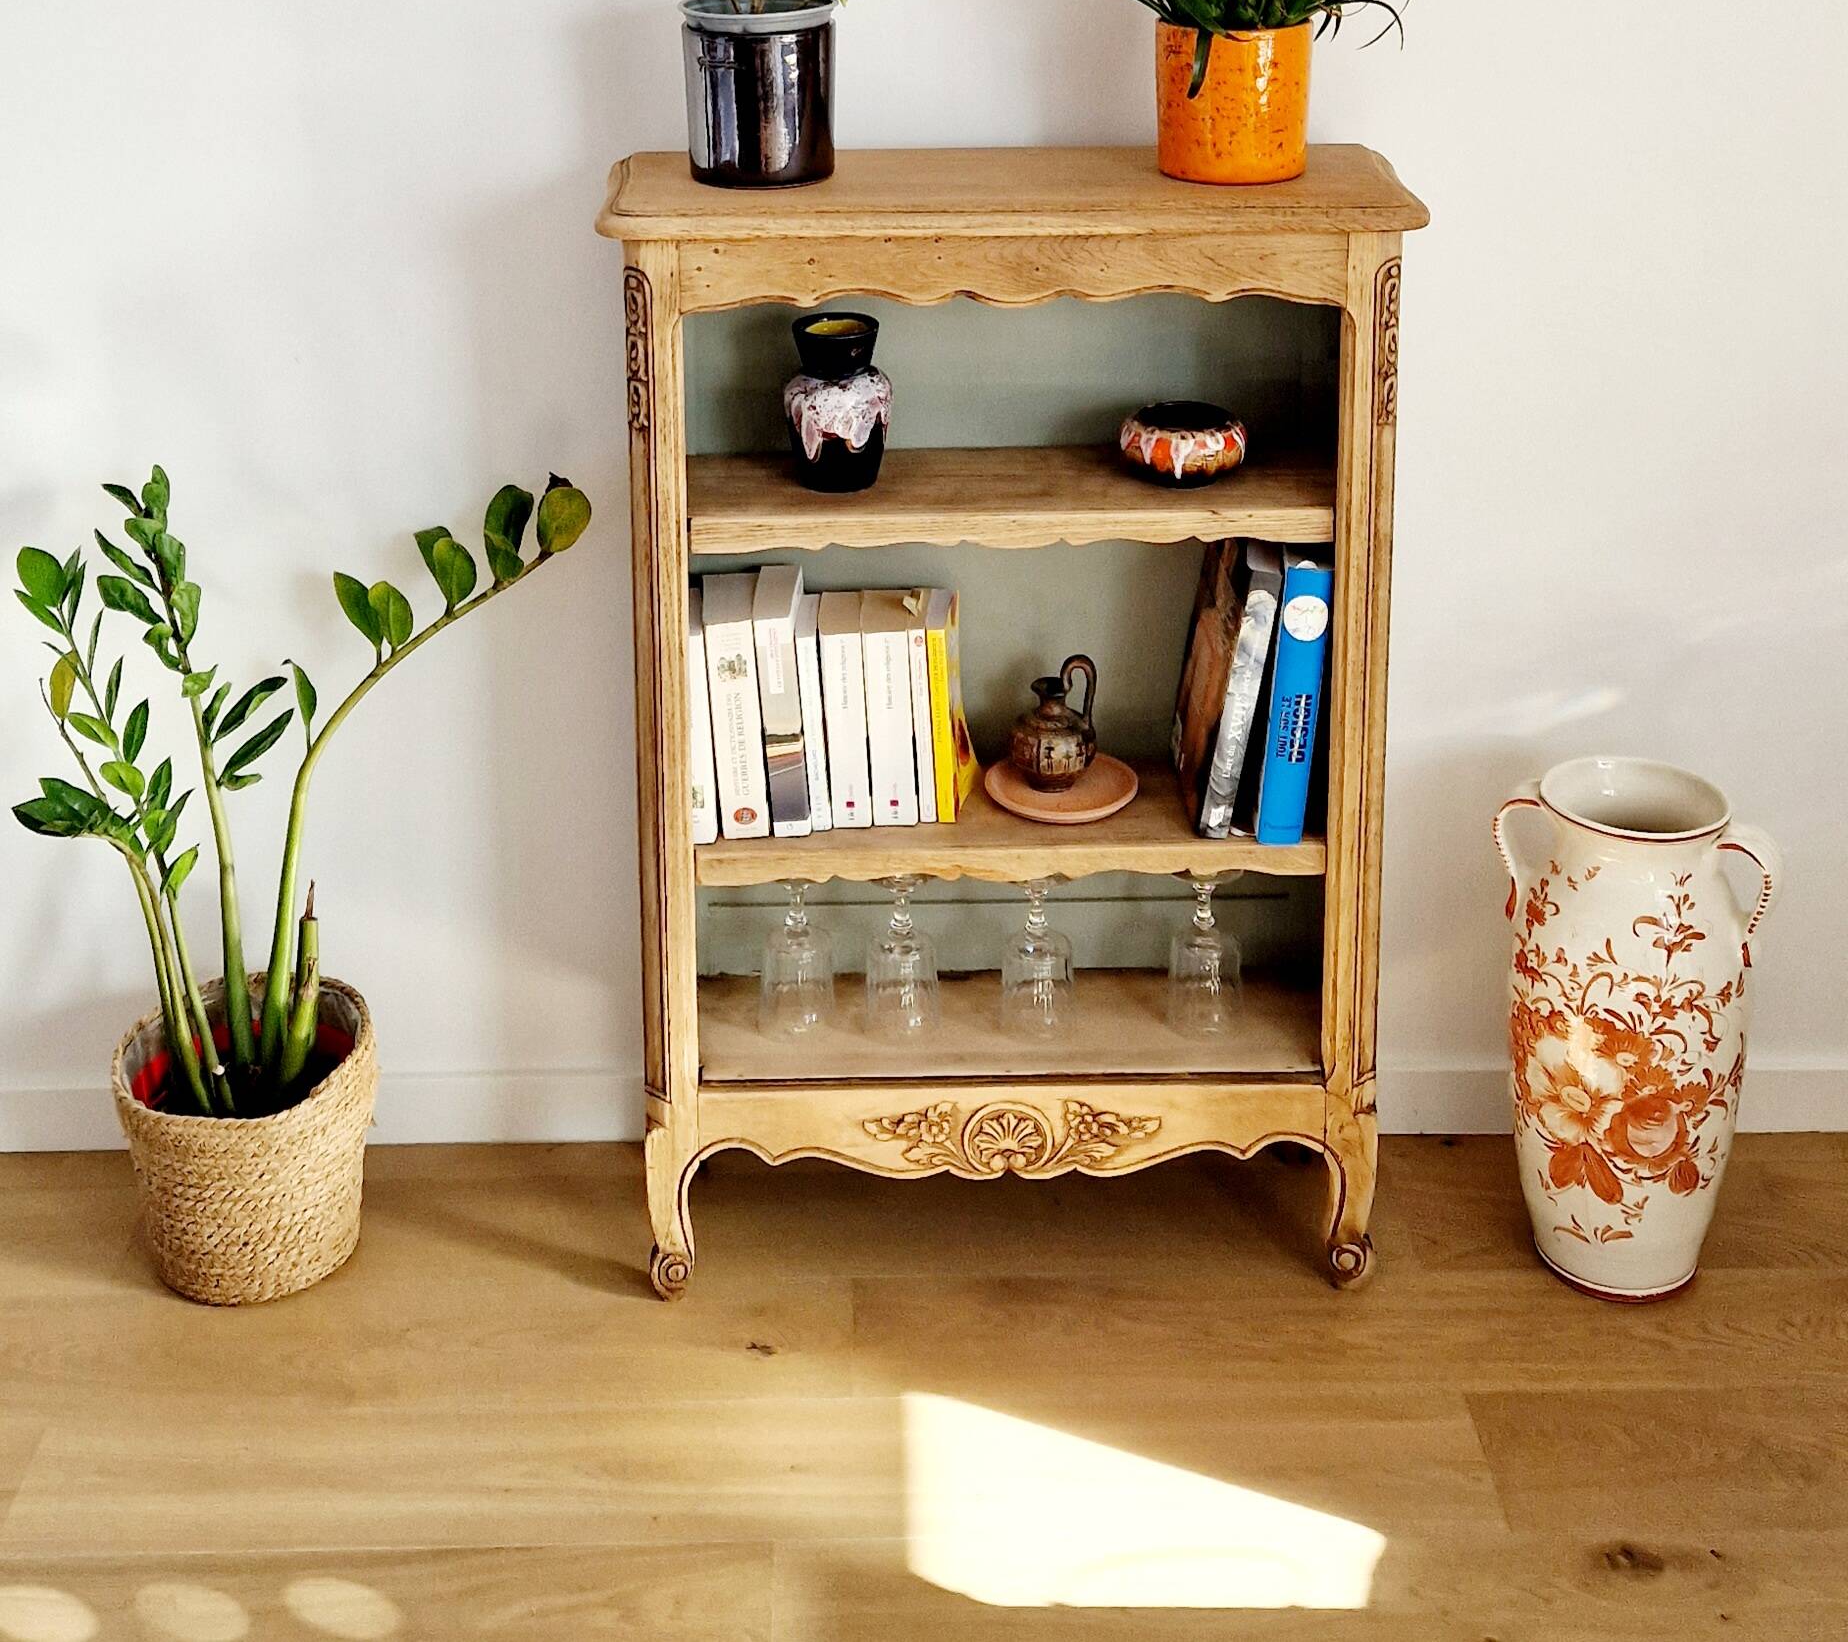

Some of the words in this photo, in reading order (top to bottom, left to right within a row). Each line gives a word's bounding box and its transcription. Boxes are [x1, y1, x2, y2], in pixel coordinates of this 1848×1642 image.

[734, 692, 745, 736] RELIGION
[1281, 695, 1293, 708] LE
[1279, 711, 1291, 731] SUR
[1287, 693, 1313, 764] DESIGN
[1276, 735, 1289, 758] TOUT
[738, 754, 750, 796] GUERRES
